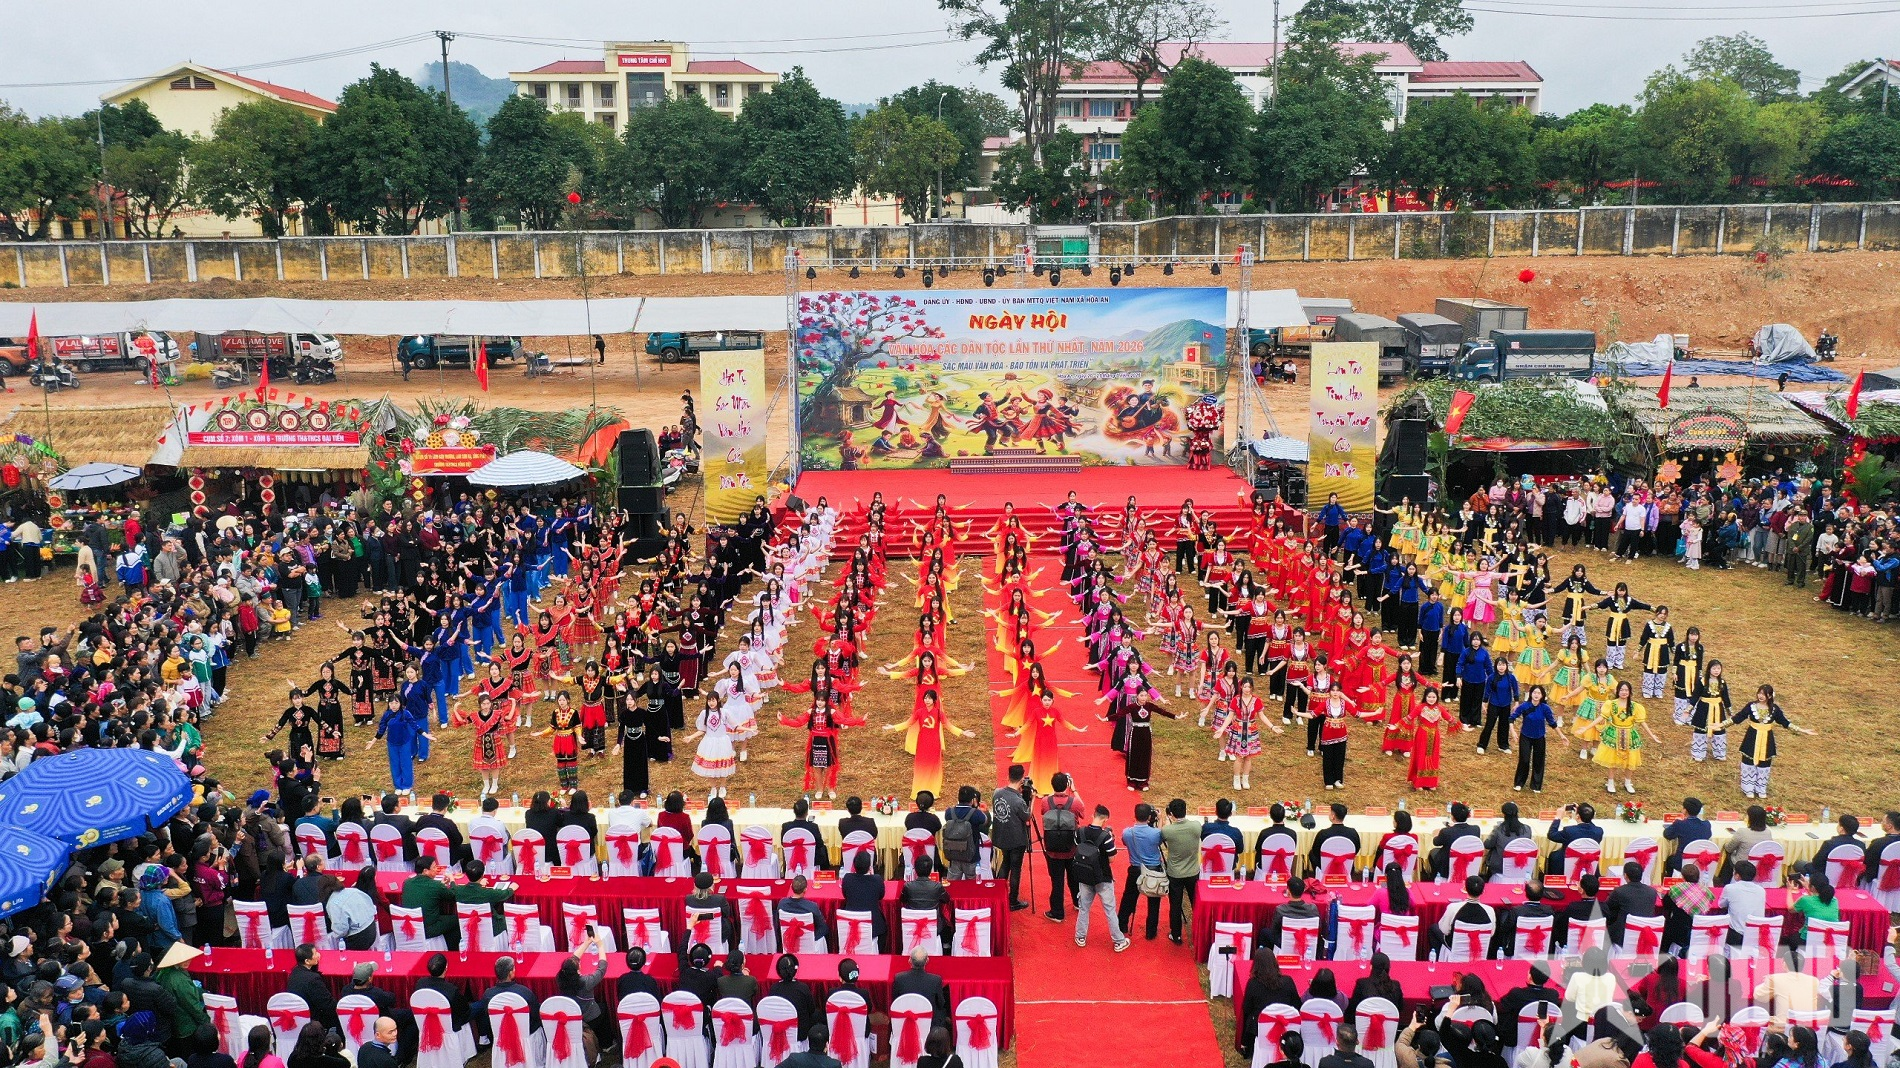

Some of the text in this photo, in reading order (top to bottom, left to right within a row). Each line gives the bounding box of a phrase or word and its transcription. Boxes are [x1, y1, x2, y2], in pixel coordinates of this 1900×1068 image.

[638, 56, 648, 64] TÂM
[1026, 297, 1044, 305] MTTQ
[1060, 296, 1075, 304] NAM
[968, 310, 1068, 333] NGÀY HỘI
[888, 337, 1145, 356] VĂN HÓA CÁC DÂN TỘC LẦN THỨ NHẤT, NĂM 2026
